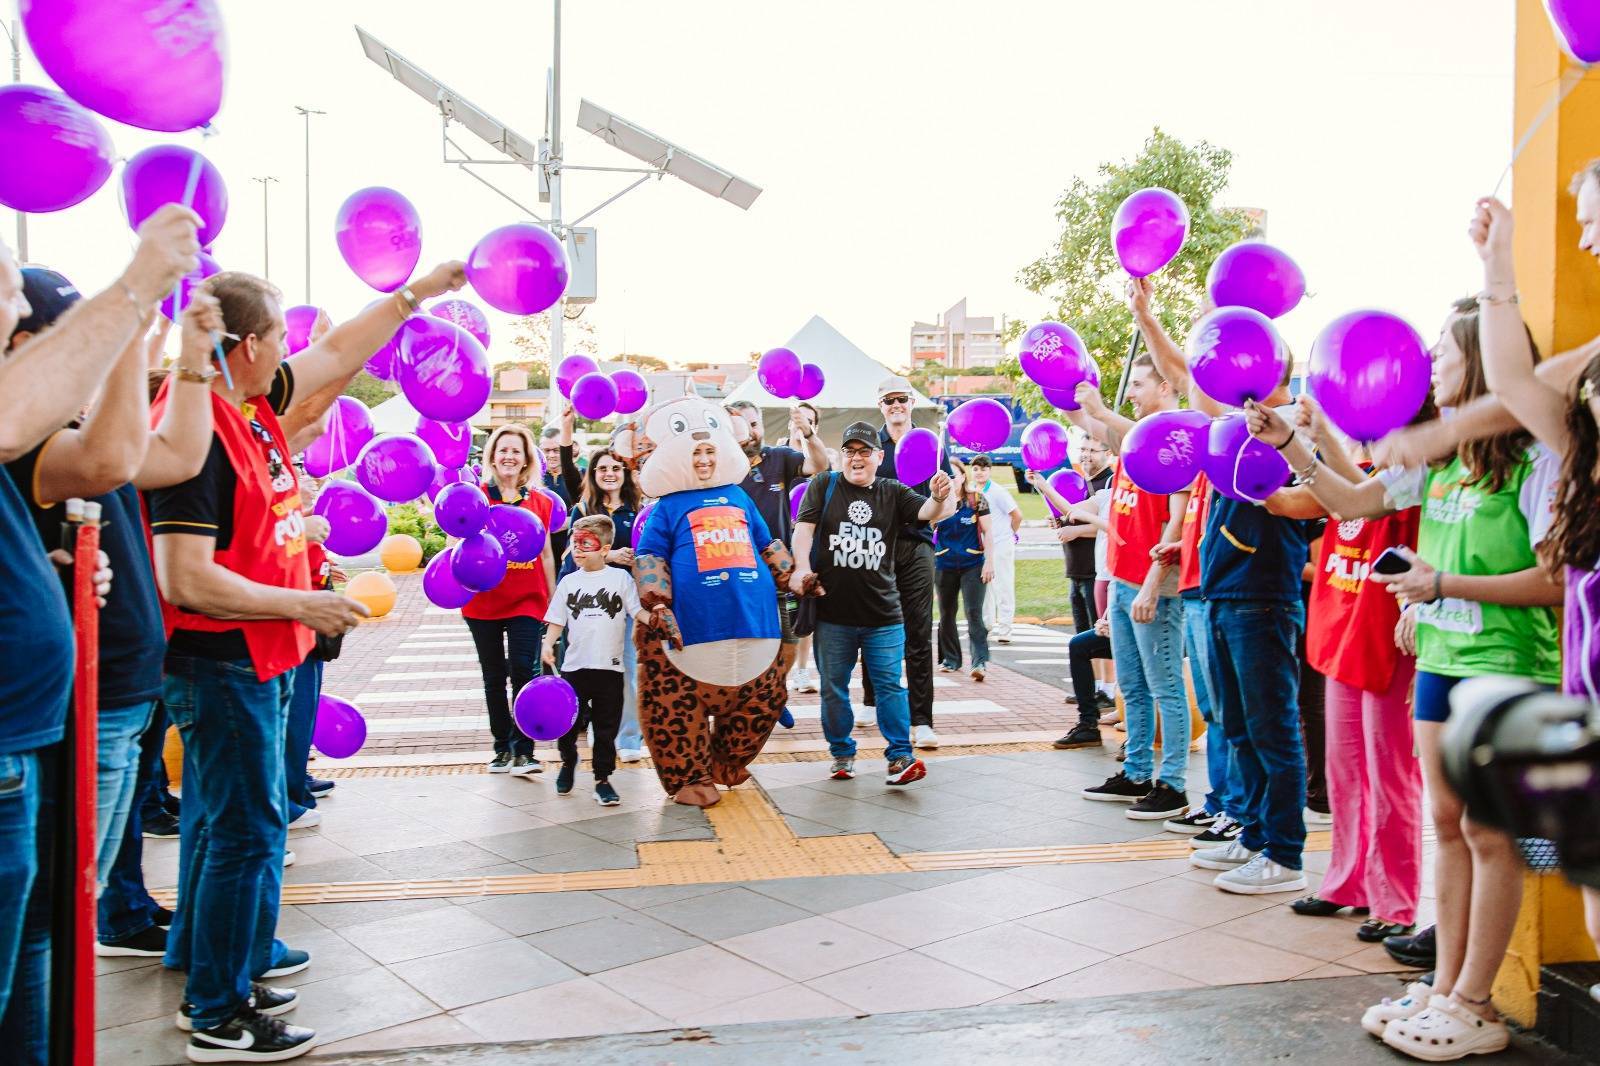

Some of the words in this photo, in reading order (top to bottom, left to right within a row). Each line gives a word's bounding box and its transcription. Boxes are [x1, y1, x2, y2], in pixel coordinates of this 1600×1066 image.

[695, 528, 748, 547] POLIO
[839, 521, 883, 542] END
[704, 542, 749, 559] NOW
[828, 534, 887, 558] POLIO
[833, 550, 882, 571] NOW
